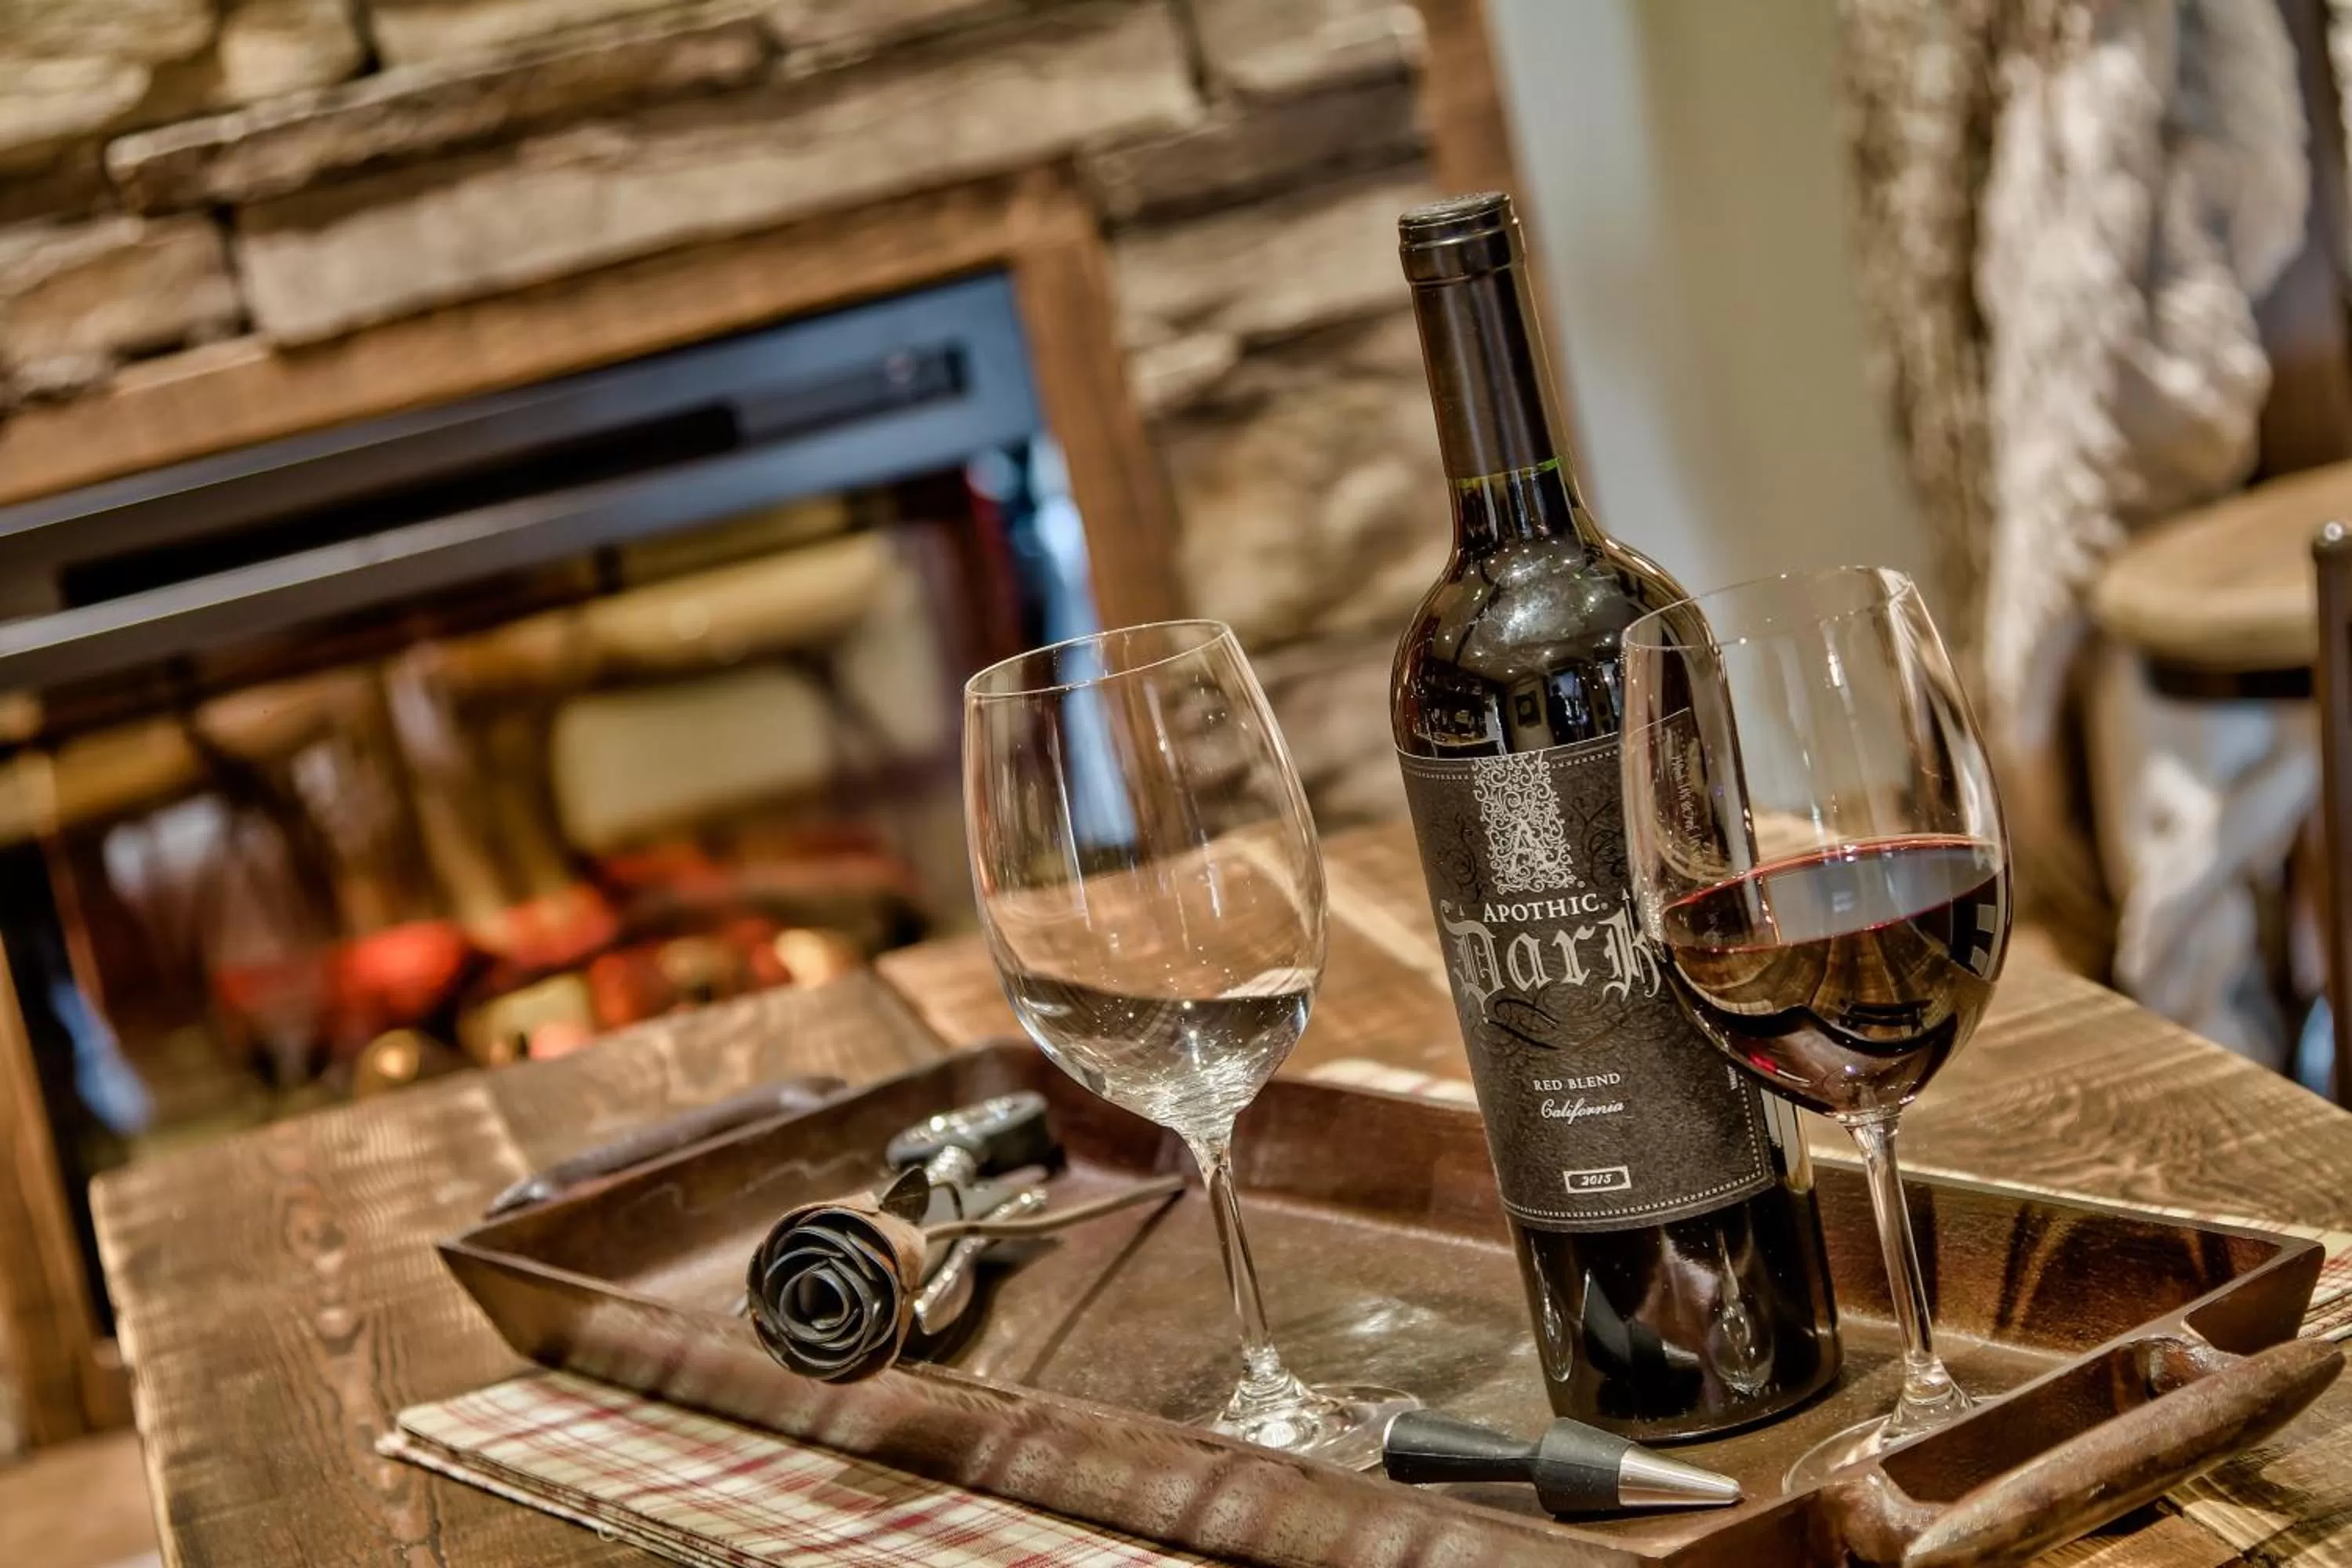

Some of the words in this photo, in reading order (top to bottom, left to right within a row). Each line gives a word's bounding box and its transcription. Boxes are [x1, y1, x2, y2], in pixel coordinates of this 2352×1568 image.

[1483, 892, 1601, 924] APOTHIC
[1440, 887, 1661, 1024] Dark
[1532, 1079, 1563, 1091] RED
[1566, 1072, 1621, 1091] BLEND
[1541, 1097, 1625, 1126] California
[1580, 1173, 1613, 1187] 2015
